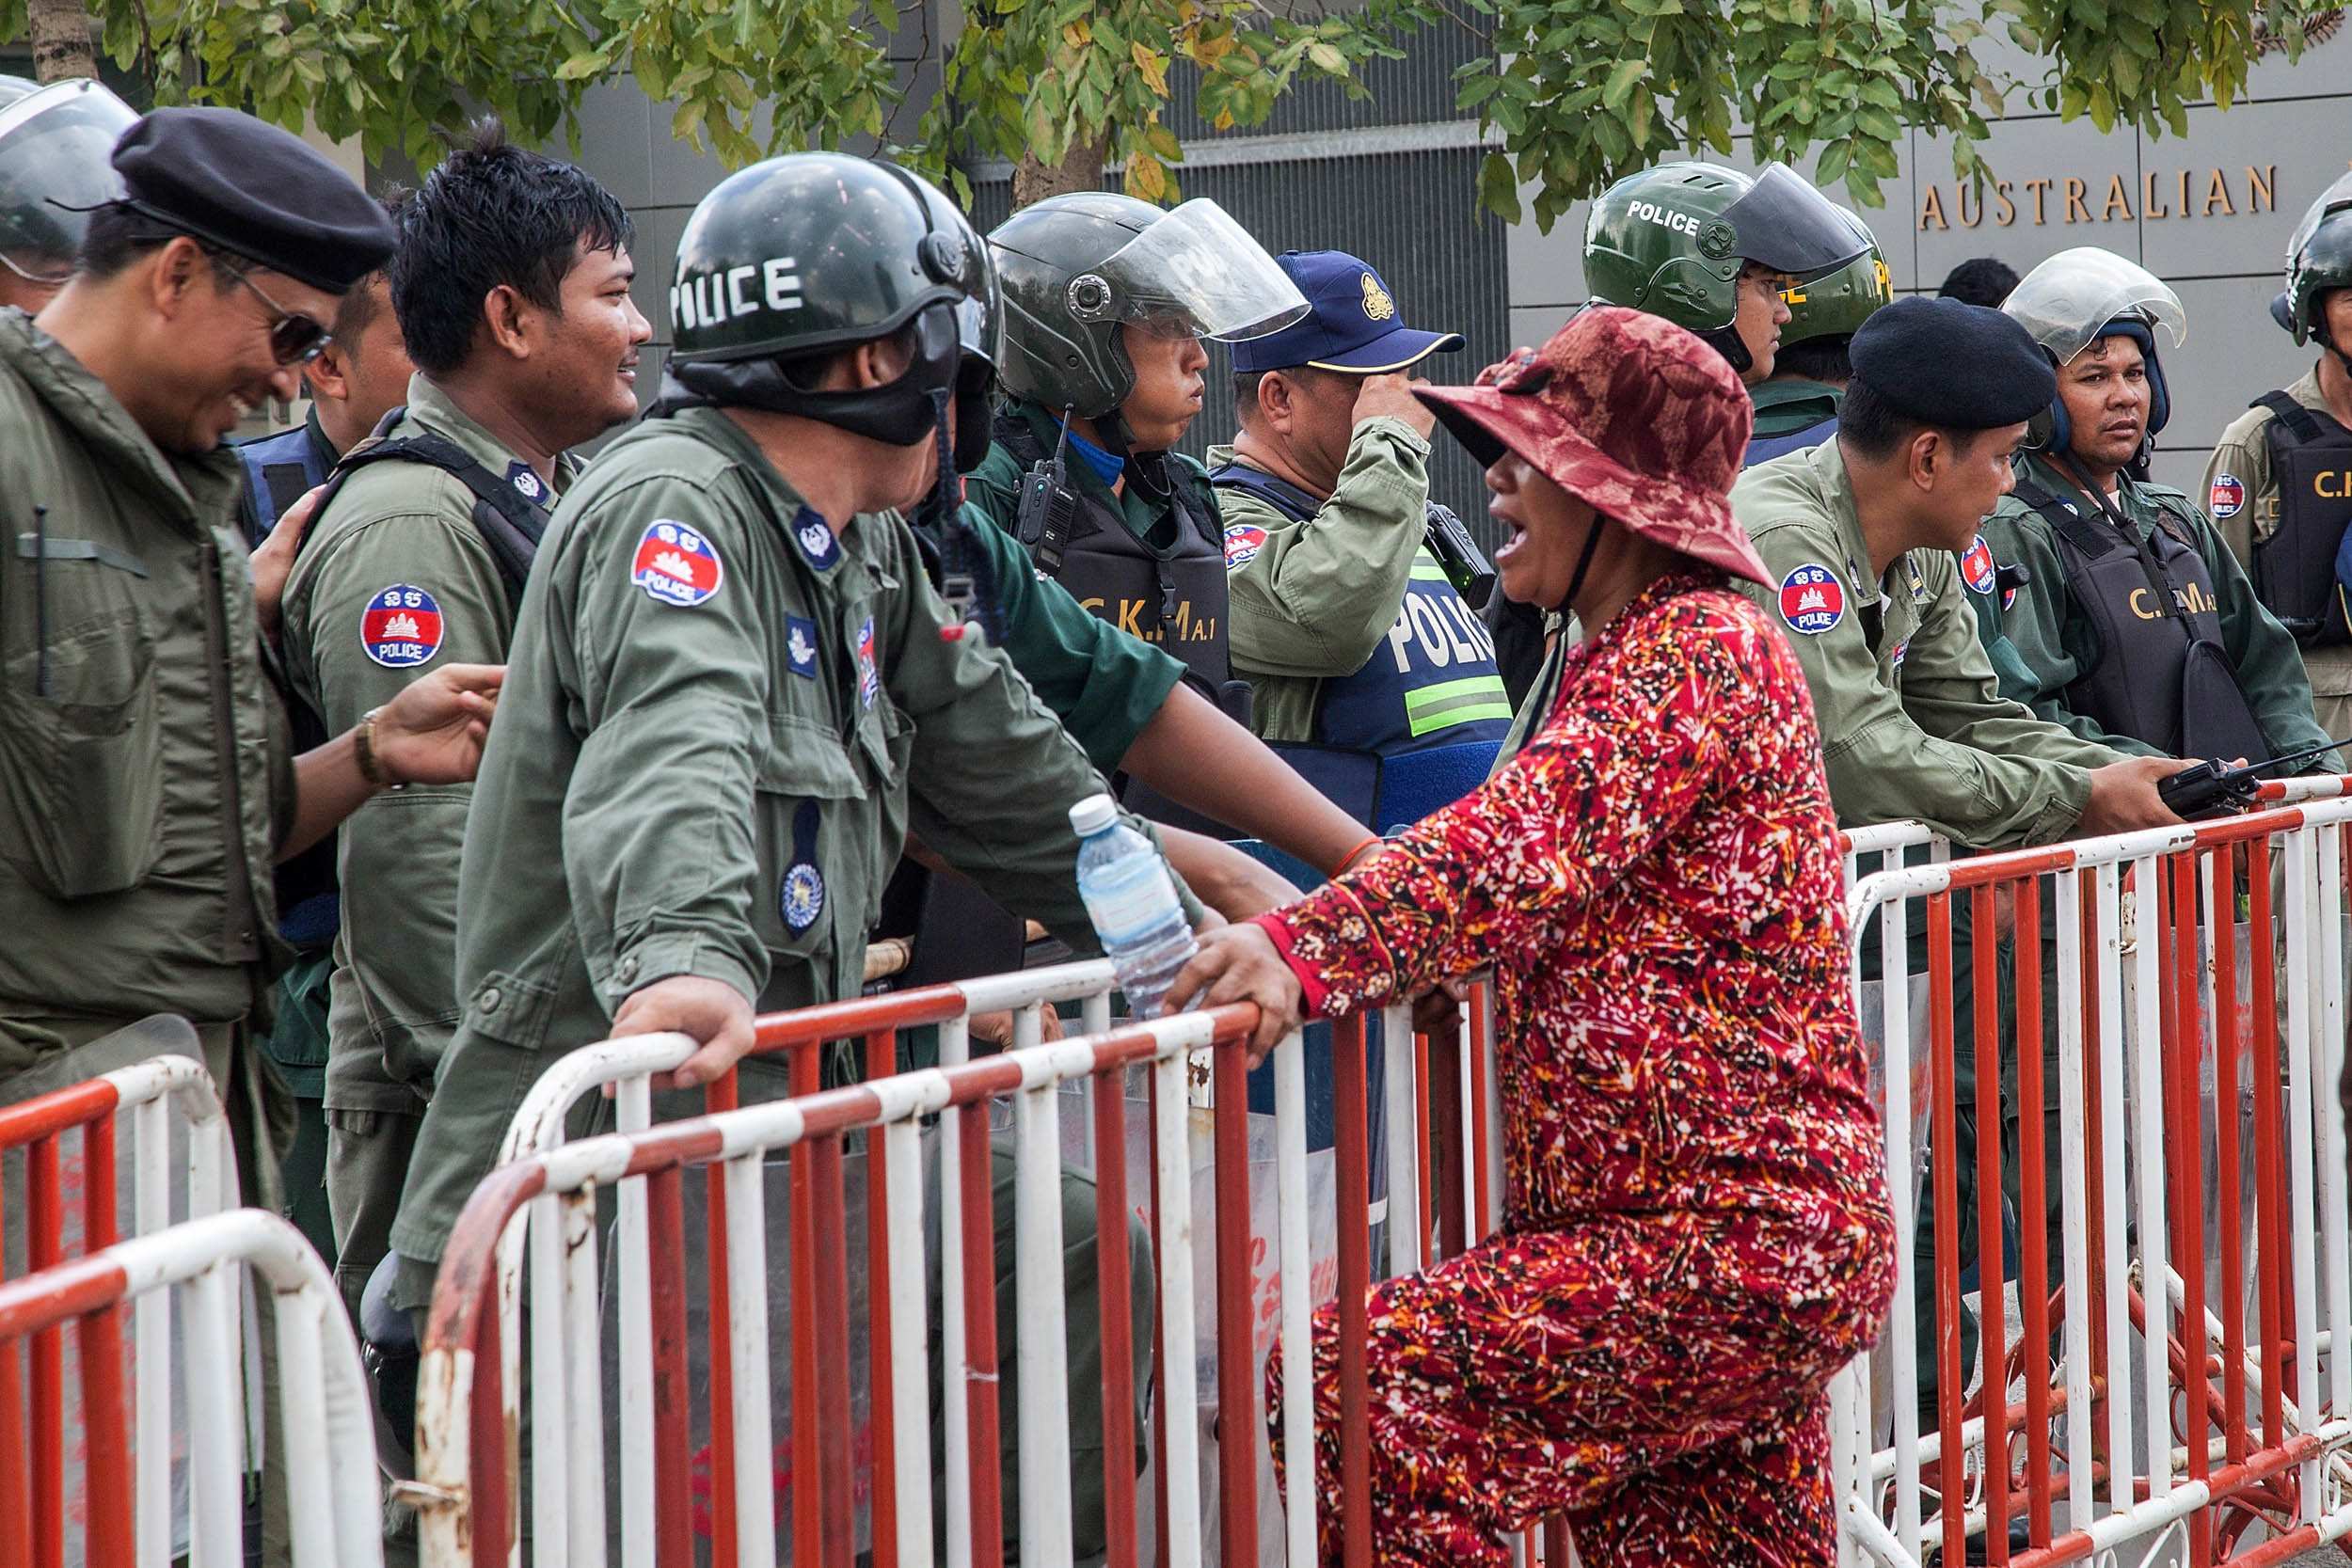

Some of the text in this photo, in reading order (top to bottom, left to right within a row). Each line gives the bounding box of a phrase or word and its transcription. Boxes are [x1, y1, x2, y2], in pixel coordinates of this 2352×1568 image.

[1919, 164, 2277, 230] AUSTRALIAN
[1627, 200, 1701, 237] POLICE
[670, 256, 803, 329] POLICE
[644, 569, 696, 601] POLICE
[1798, 611, 1832, 628] POLICE
[379, 642, 422, 660] POLICE
